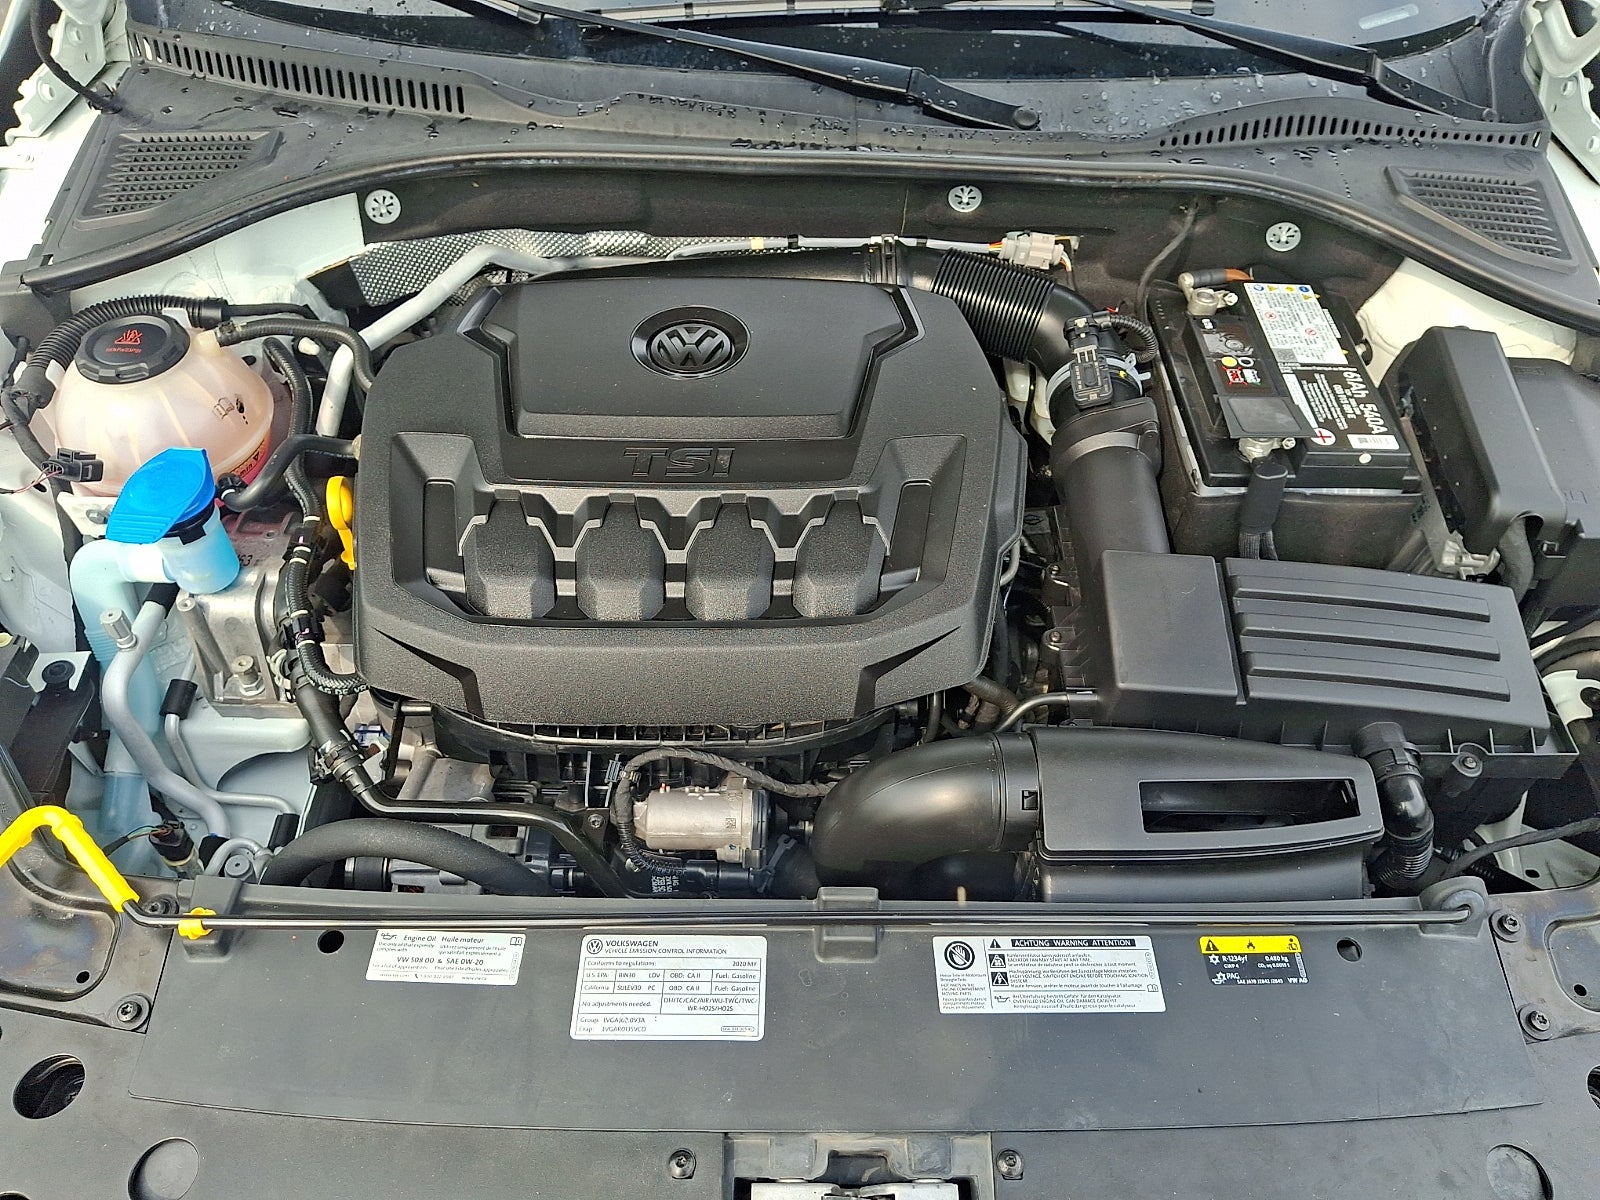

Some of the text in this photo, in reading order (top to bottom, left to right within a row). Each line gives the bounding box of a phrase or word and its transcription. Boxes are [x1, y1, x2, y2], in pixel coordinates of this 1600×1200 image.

[1343, 371, 1369, 398] 61Ah
[1359, 403, 1388, 434] 540A
[623, 447, 736, 477] TSI
[403, 934, 426, 943] Engine
[460, 958, 484, 966] 0W-20
[1221, 955, 1248, 963] R-1234yf
[1280, 955, 1289, 963] kg
